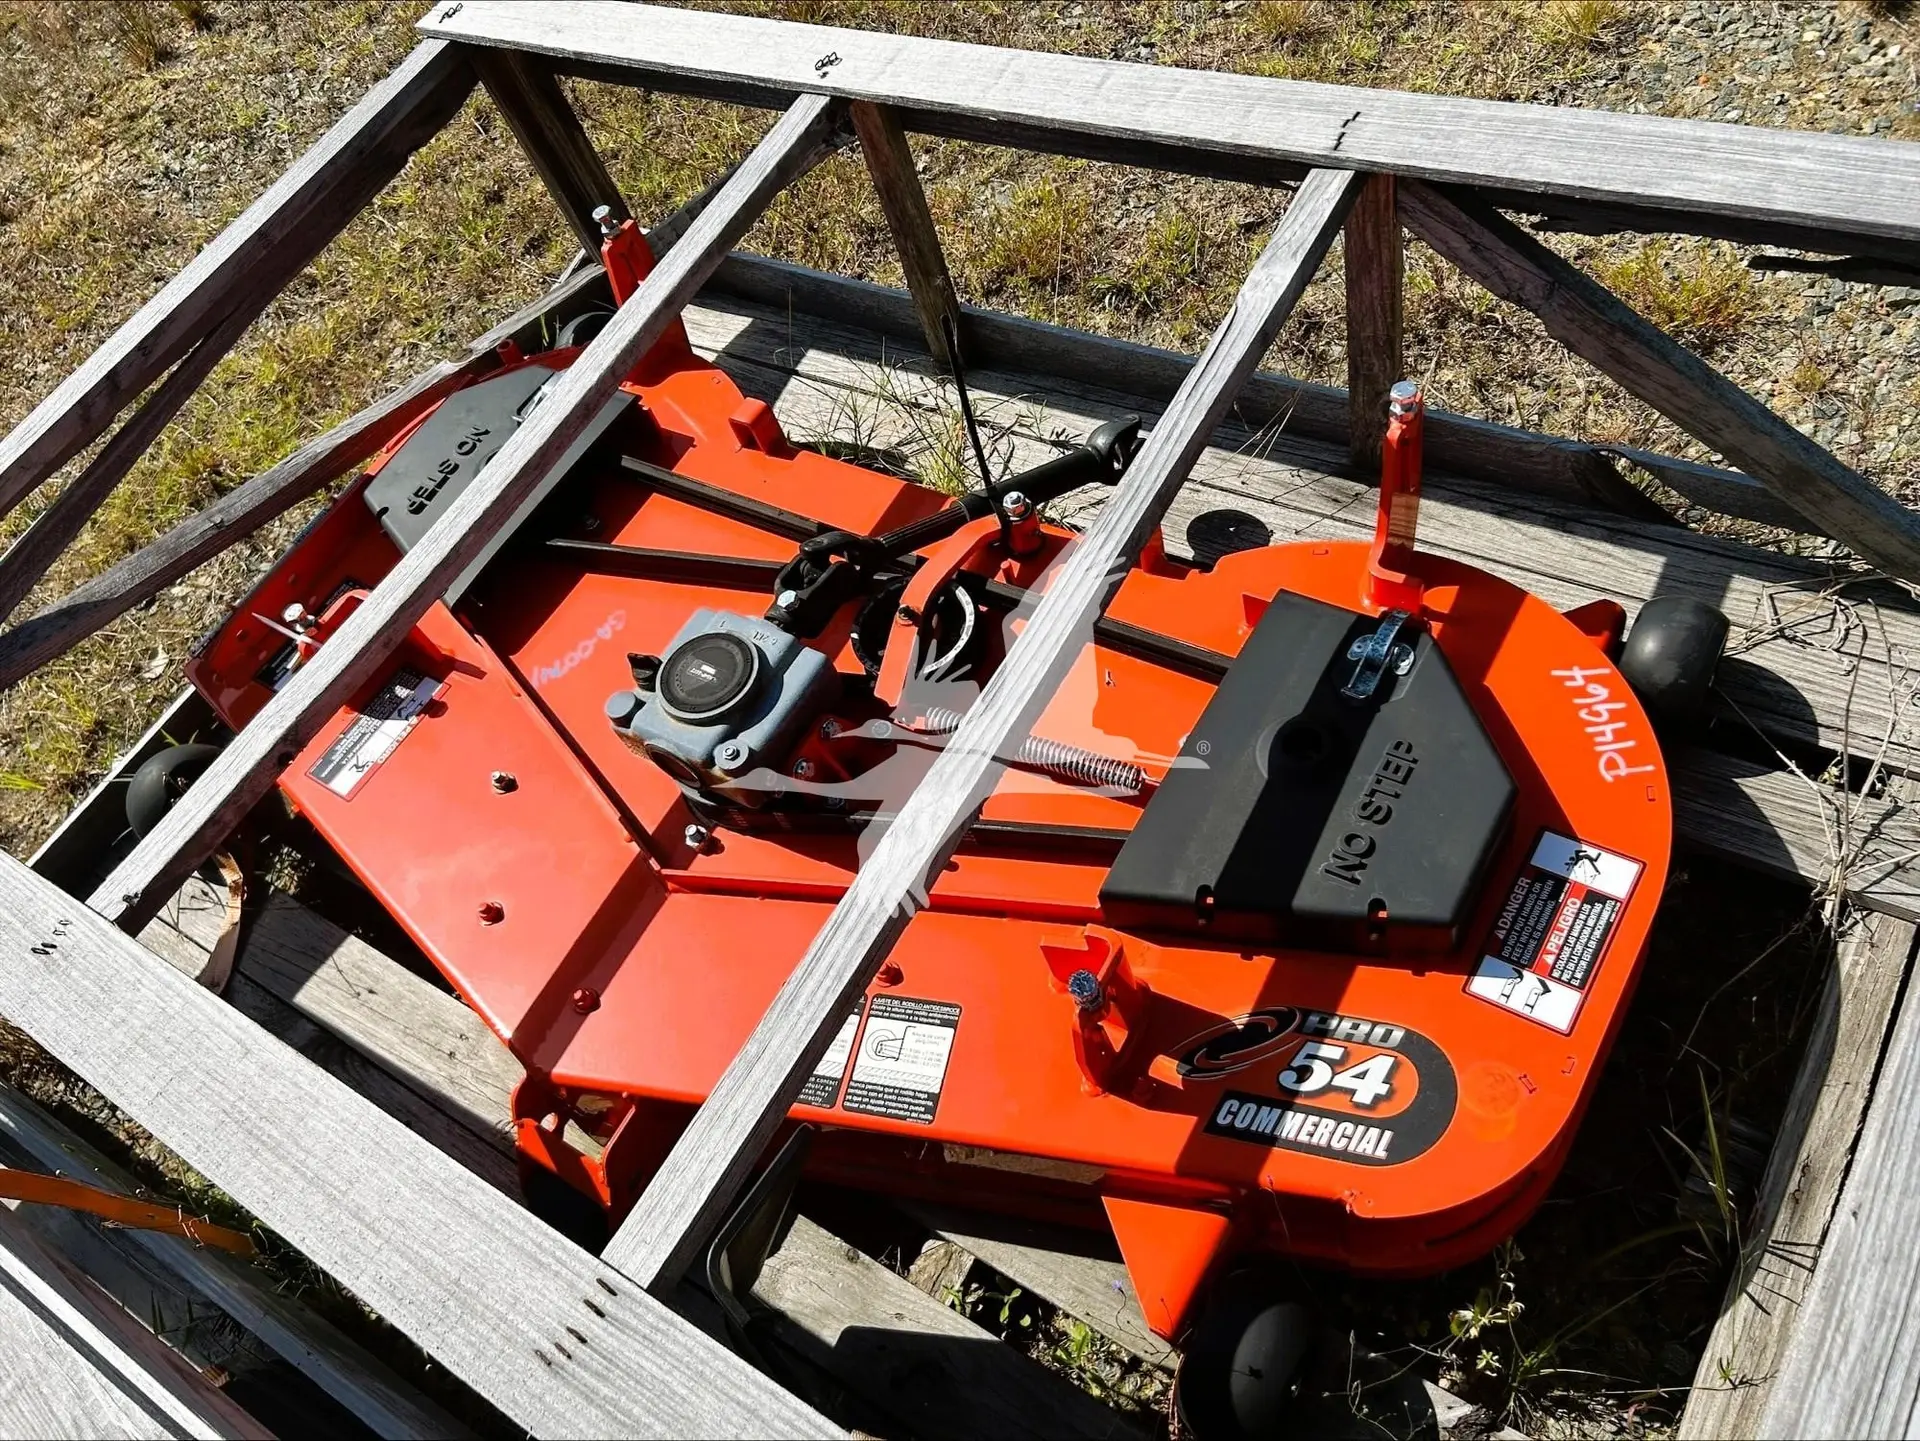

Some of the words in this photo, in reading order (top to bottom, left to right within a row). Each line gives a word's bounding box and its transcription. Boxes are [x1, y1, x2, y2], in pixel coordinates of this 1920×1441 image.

[456, 425, 492, 456] NO
[407, 458, 460, 515] STEP
[1317, 831, 1377, 888] NO
[1357, 739, 1420, 826] STEP
[1498, 878, 1530, 928] DANGER
[1502, 946, 1511, 957] DO
[1507, 931, 1518, 946] NOT
[1514, 917, 1525, 931] PUT
[1521, 894, 1536, 916] HANDS
[1532, 882, 1542, 893] OR
[1511, 943, 1524, 960] FEET
[1520, 926, 1532, 943] INTO
[1527, 900, 1544, 926] MOWER
[1540, 880, 1554, 899] WHEN
[1547, 898, 1580, 952] PELIGRO
[1520, 939, 1537, 964] ENGINE
[1302, 1014, 1406, 1048] PRO
[1278, 1040, 1398, 1105] 54
[1216, 1098, 1394, 1160] COMMERCIAL
